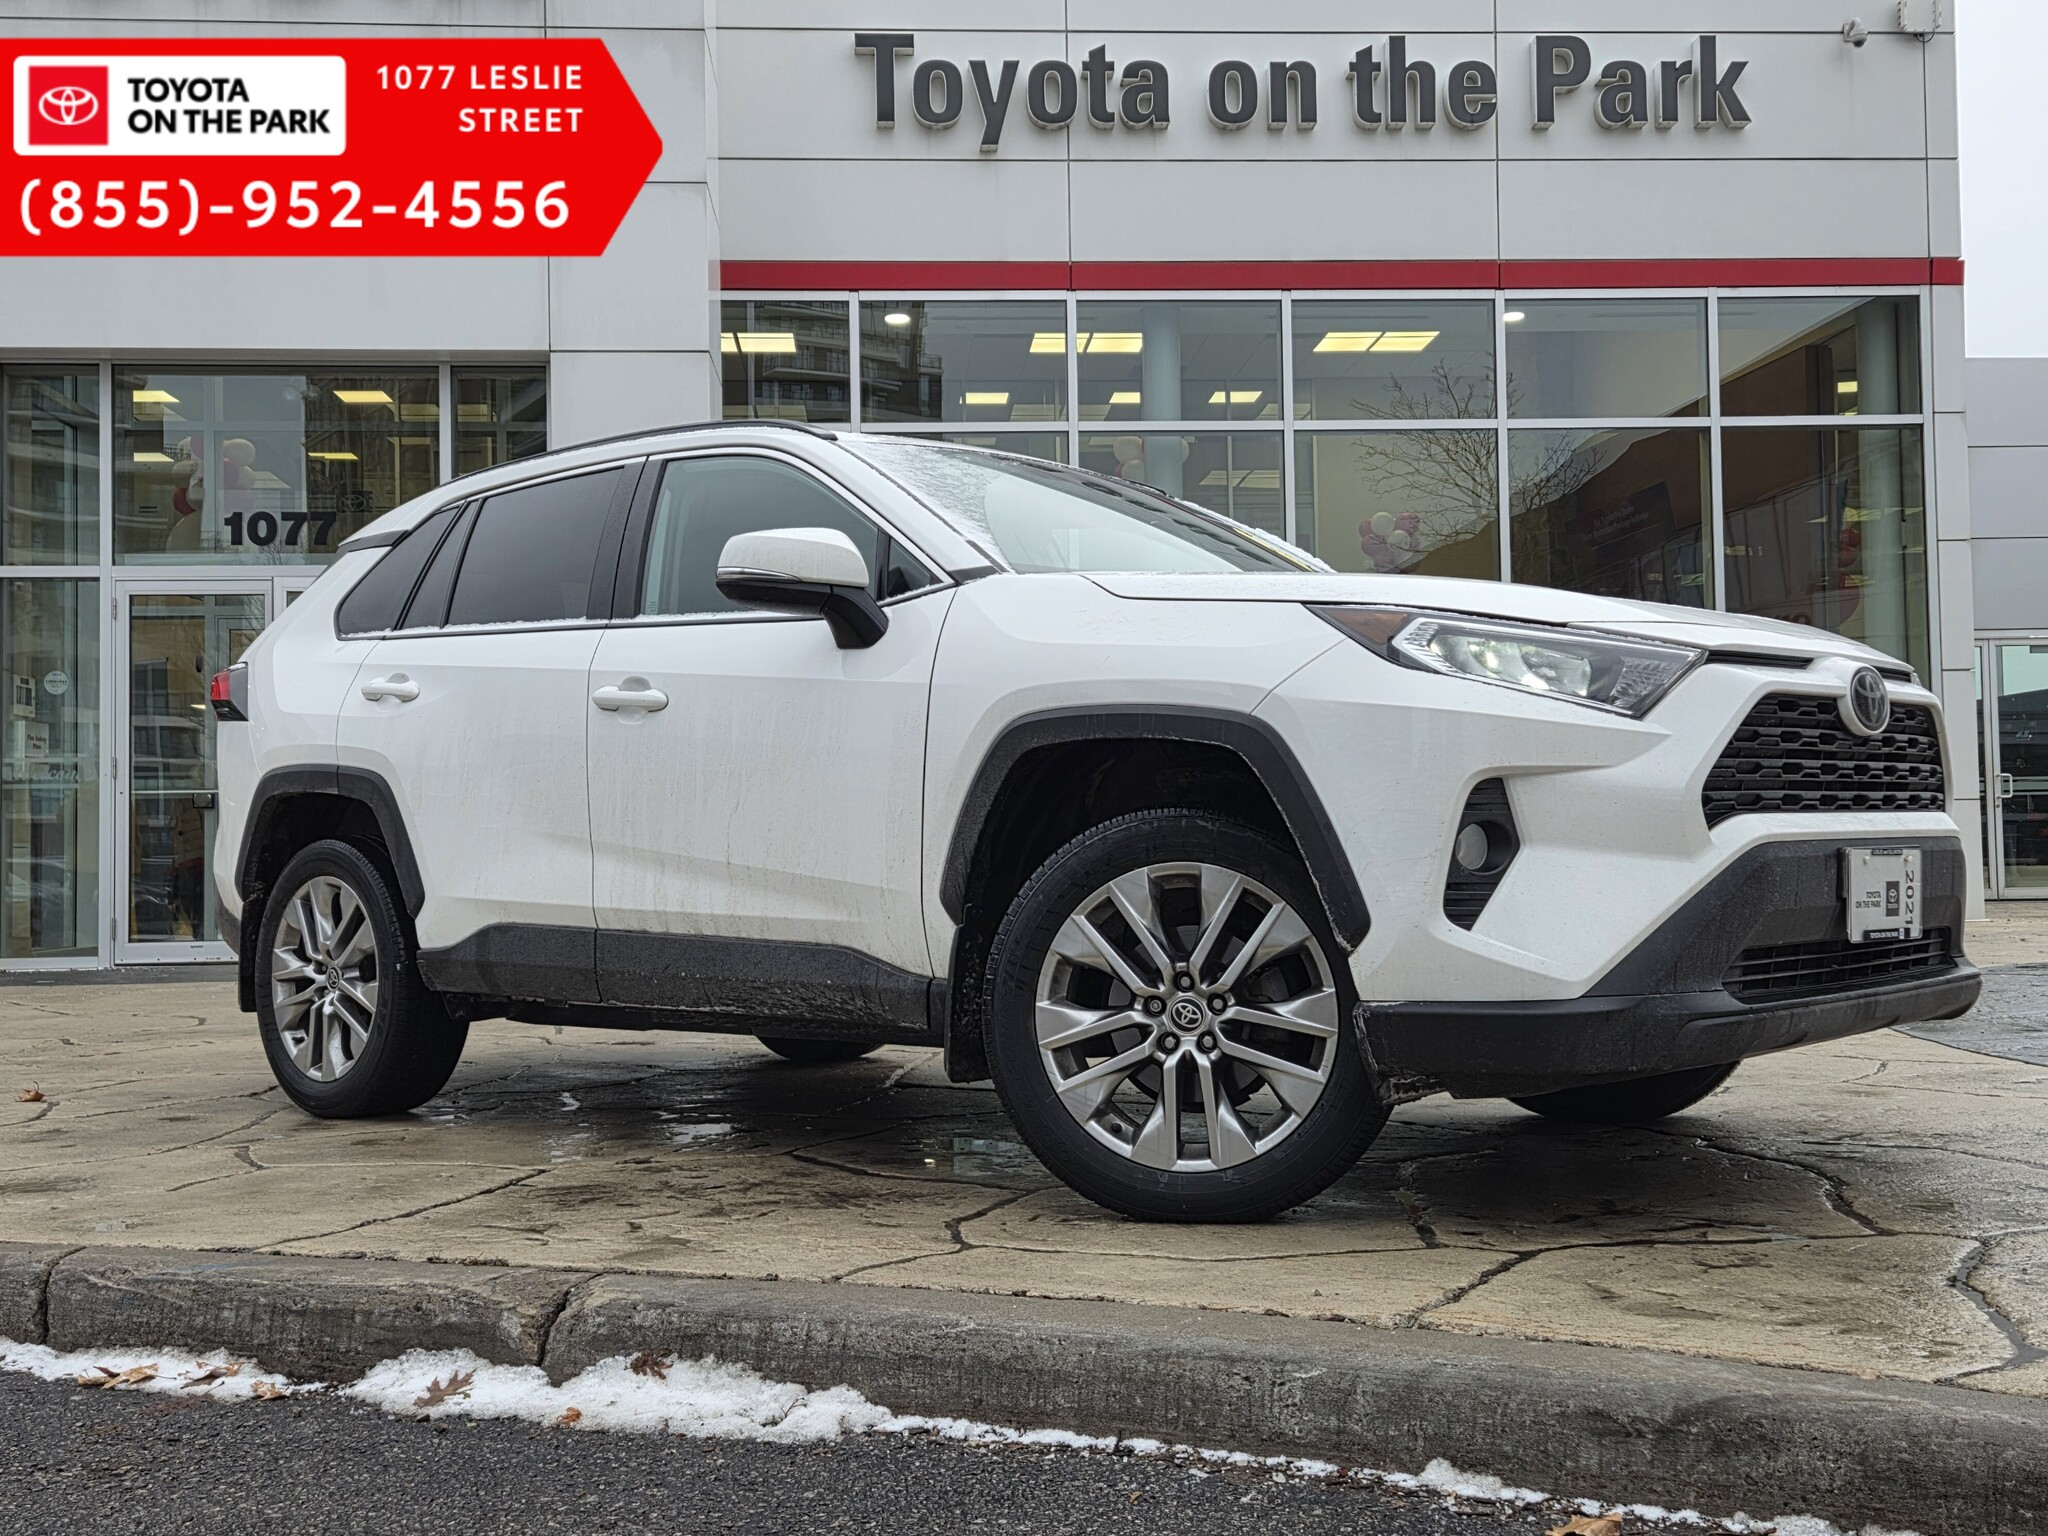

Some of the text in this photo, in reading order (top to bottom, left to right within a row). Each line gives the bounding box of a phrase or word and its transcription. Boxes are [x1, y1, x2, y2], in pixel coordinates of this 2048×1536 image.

[854, 32, 1752, 153] Toyota on the Park
[224, 511, 337, 546] 1077
[1905, 869, 1915, 925] 2021
